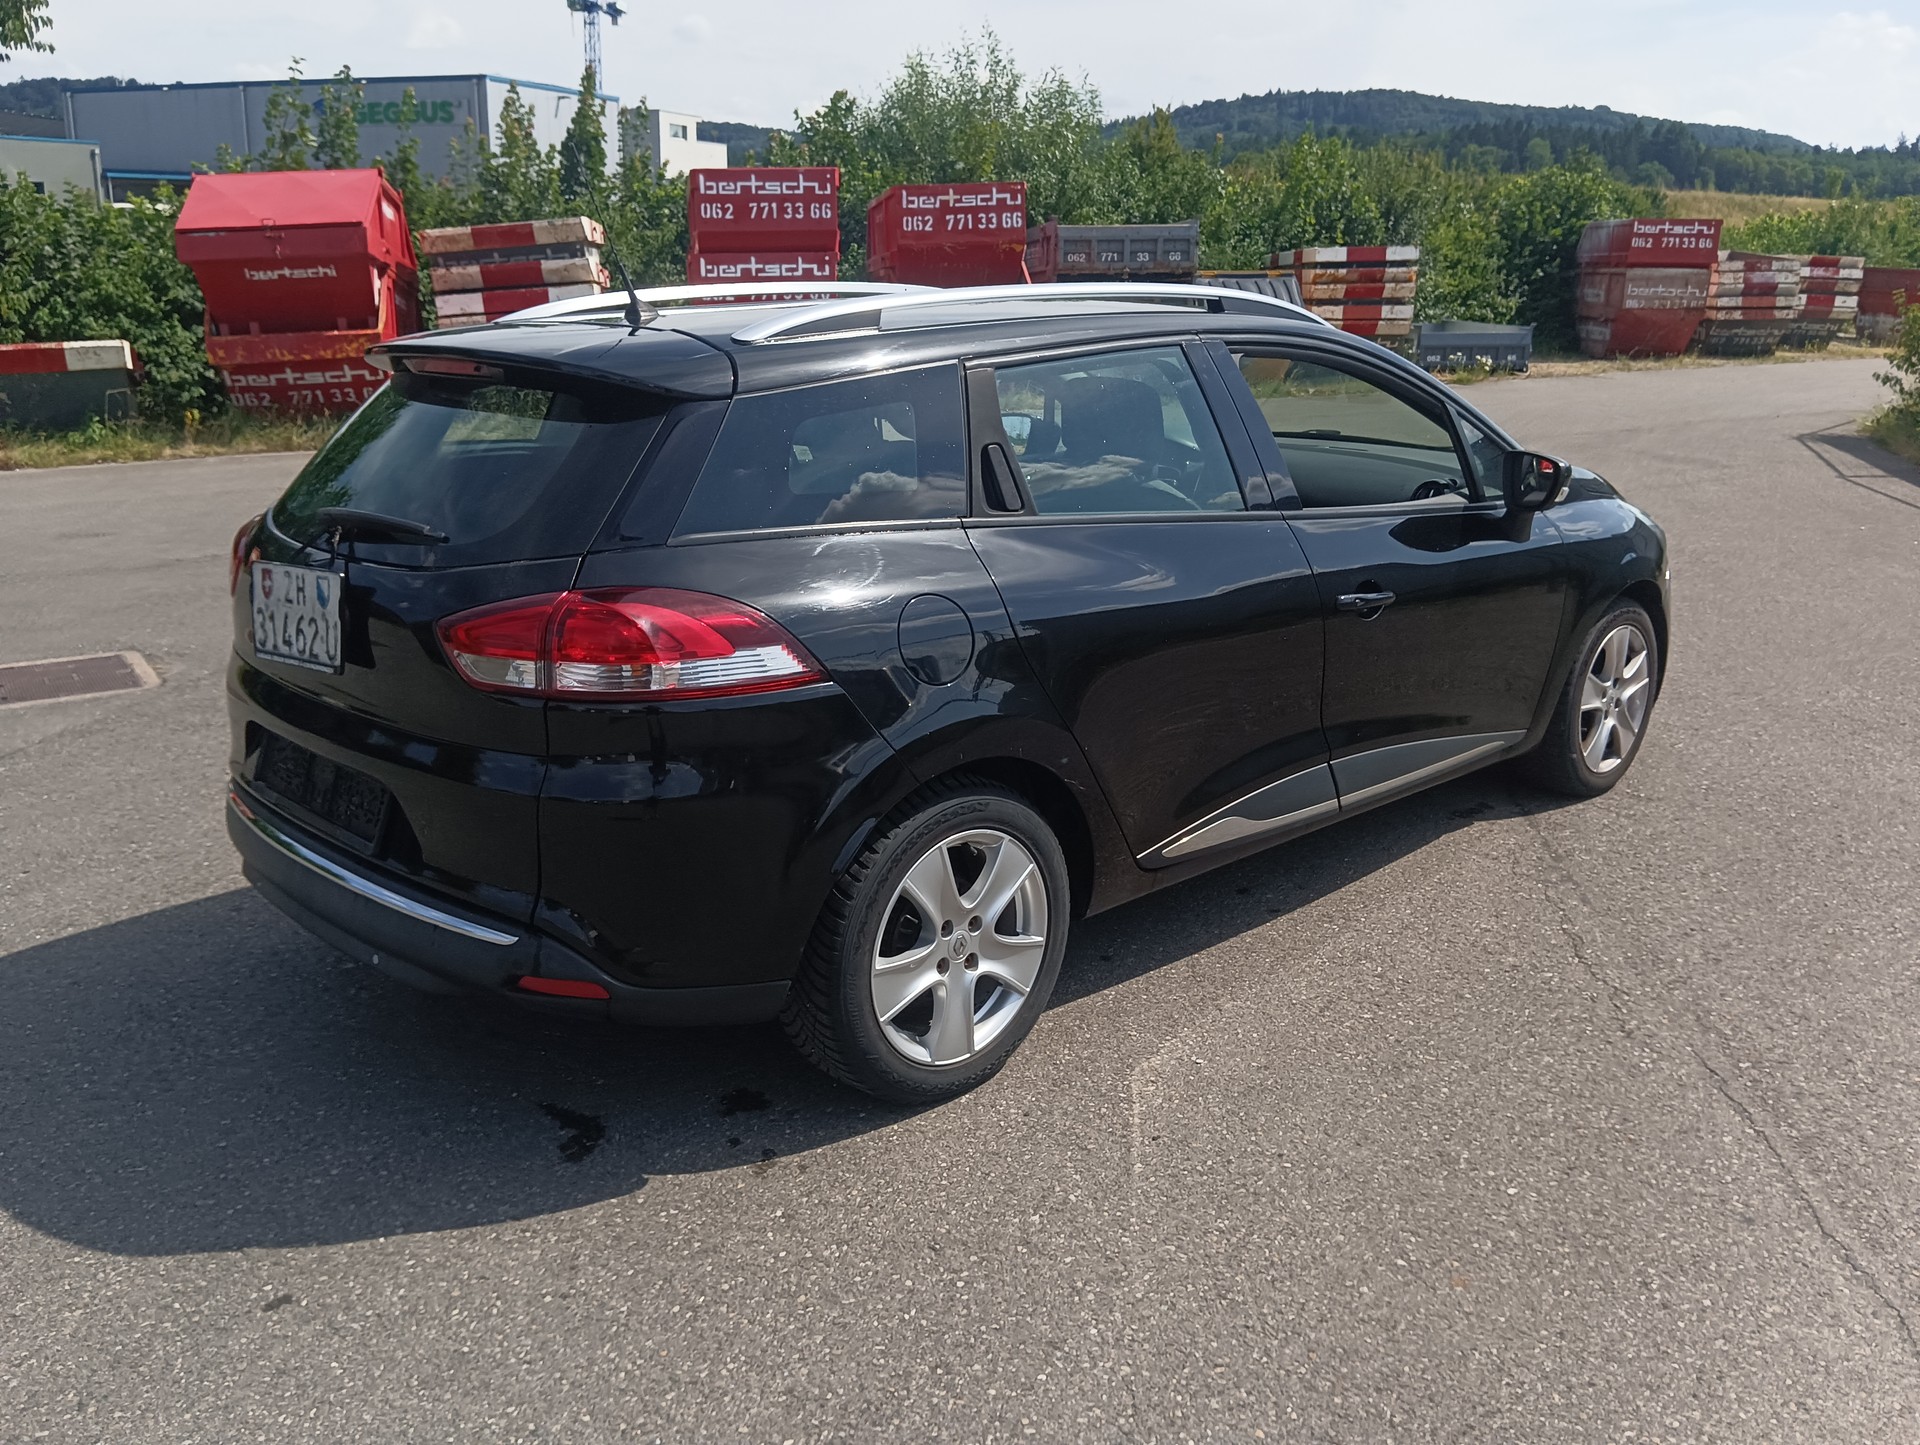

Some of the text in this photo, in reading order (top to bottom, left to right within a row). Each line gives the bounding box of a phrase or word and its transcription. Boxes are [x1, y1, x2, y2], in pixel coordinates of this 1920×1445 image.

[699, 174, 831, 194] bertschi
[902, 187, 1022, 208] bertschi
[701, 202, 832, 219] 062 771 33 66
[903, 211, 1022, 231] 062 771 33 66
[1634, 221, 1715, 235] bertschi
[1632, 237, 1713, 248] 062 771 33 66
[700, 256, 830, 277] bertschi
[1067, 252, 1181, 262] 062 771 33 66
[244, 264, 337, 280] bertschi
[223, 364, 385, 387] bertschi
[229, 392, 272, 407] 062
[288, 389, 325, 405] 771
[329, 387, 357, 403] 33
